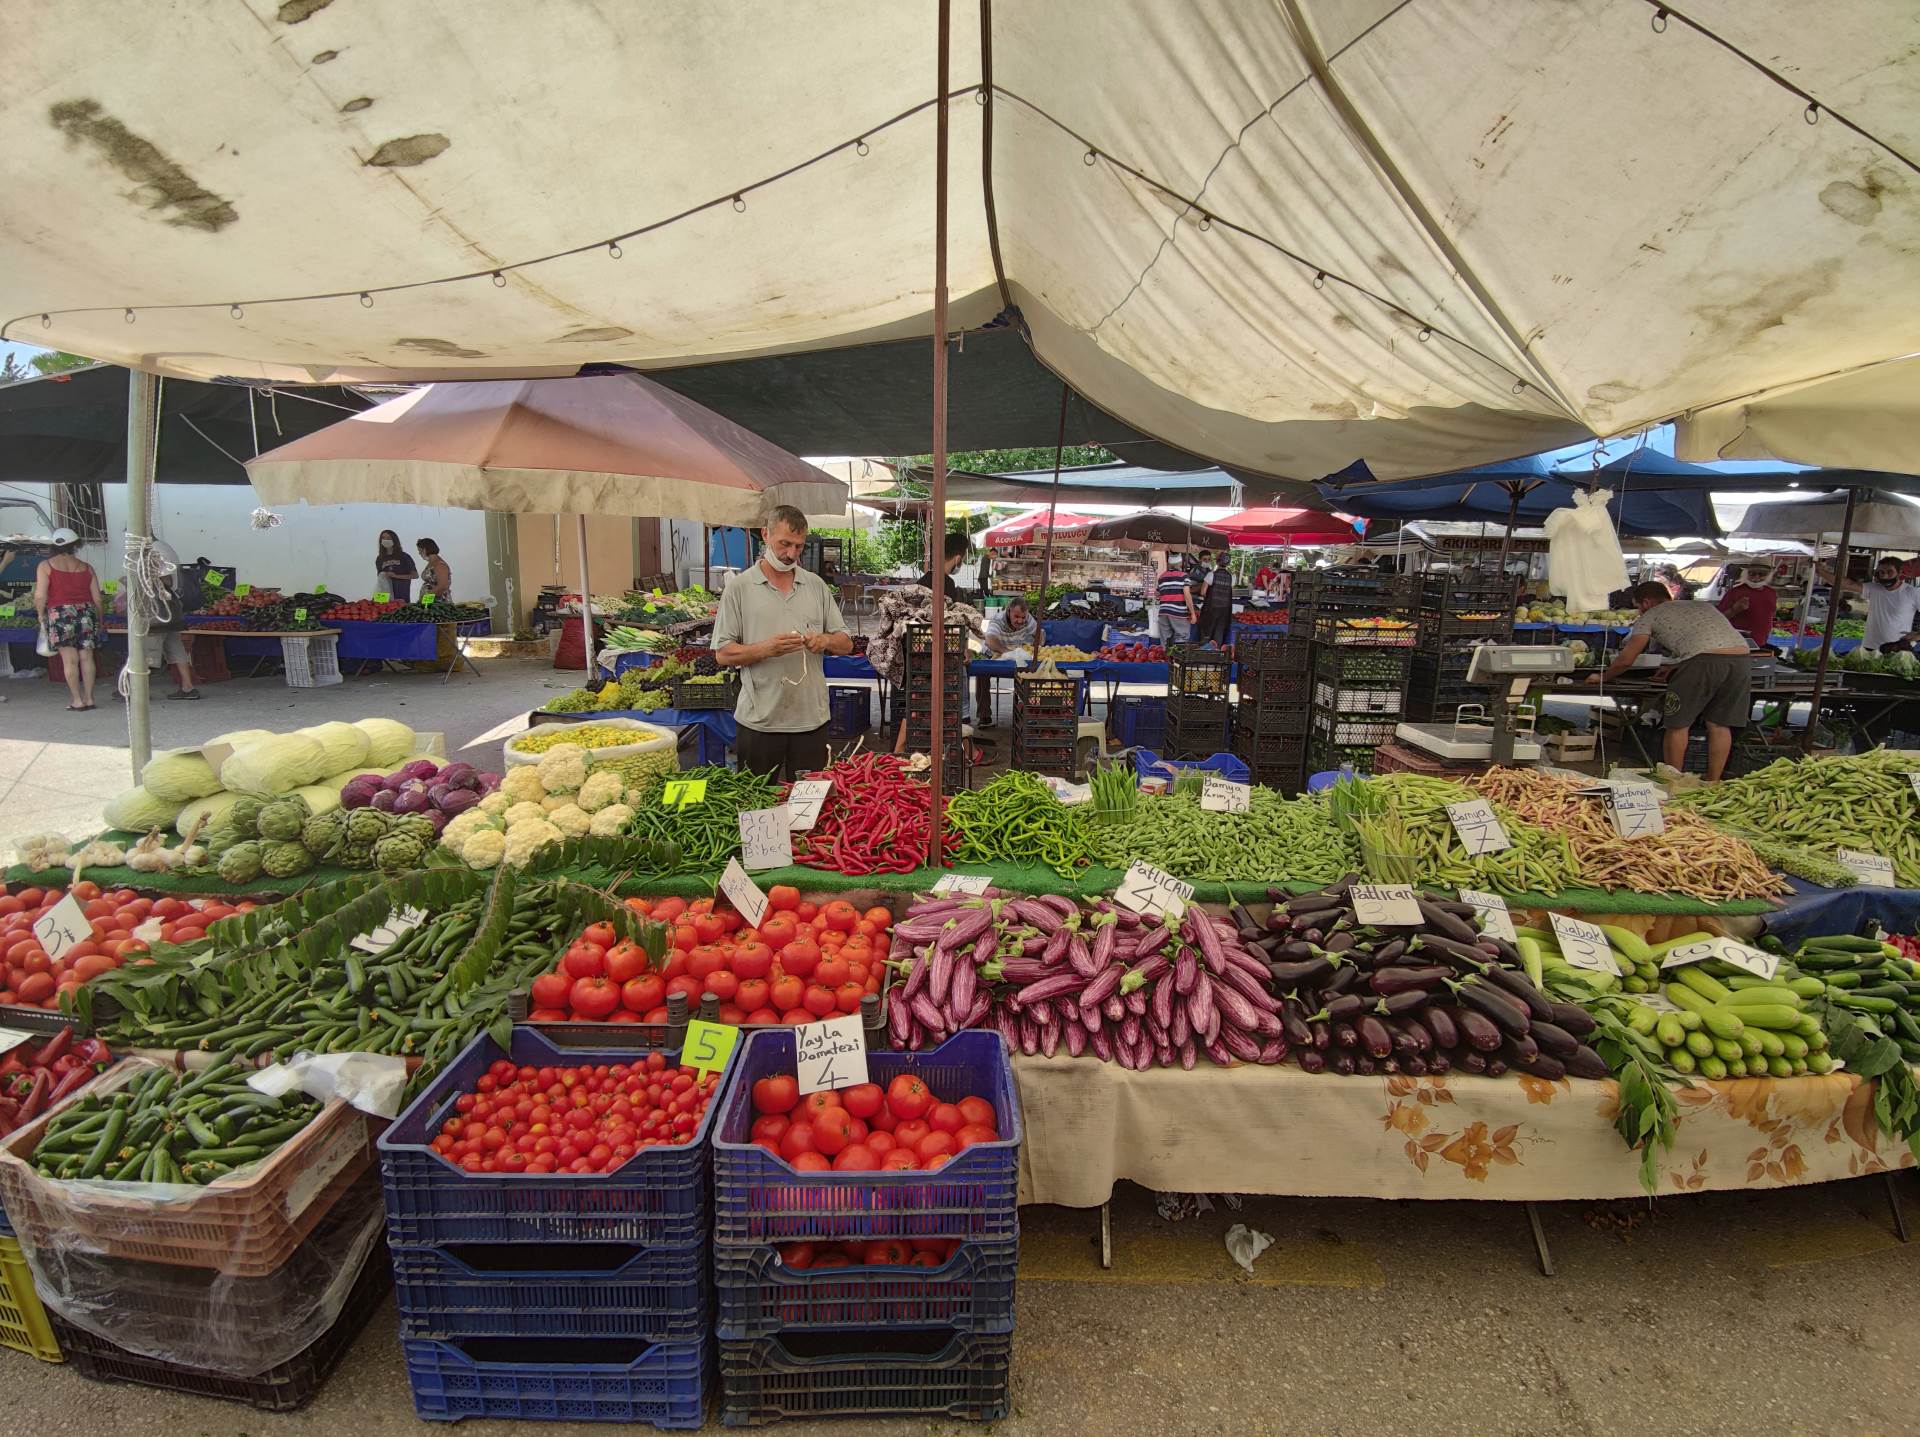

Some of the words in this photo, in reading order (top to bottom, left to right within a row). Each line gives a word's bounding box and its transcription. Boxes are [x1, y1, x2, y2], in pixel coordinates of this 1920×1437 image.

[788, 801, 813, 827] 7
[1625, 812, 1647, 838] 7
[1465, 823, 1496, 853] 7
[742, 892, 765, 918] 4
[1131, 884, 1164, 912] 4
[1360, 902, 1388, 924] 3
[1572, 939, 1599, 965] 3
[694, 1028, 722, 1061] 5
[798, 1038, 861, 1064] Domatezi
[816, 1056, 849, 1090] 4
